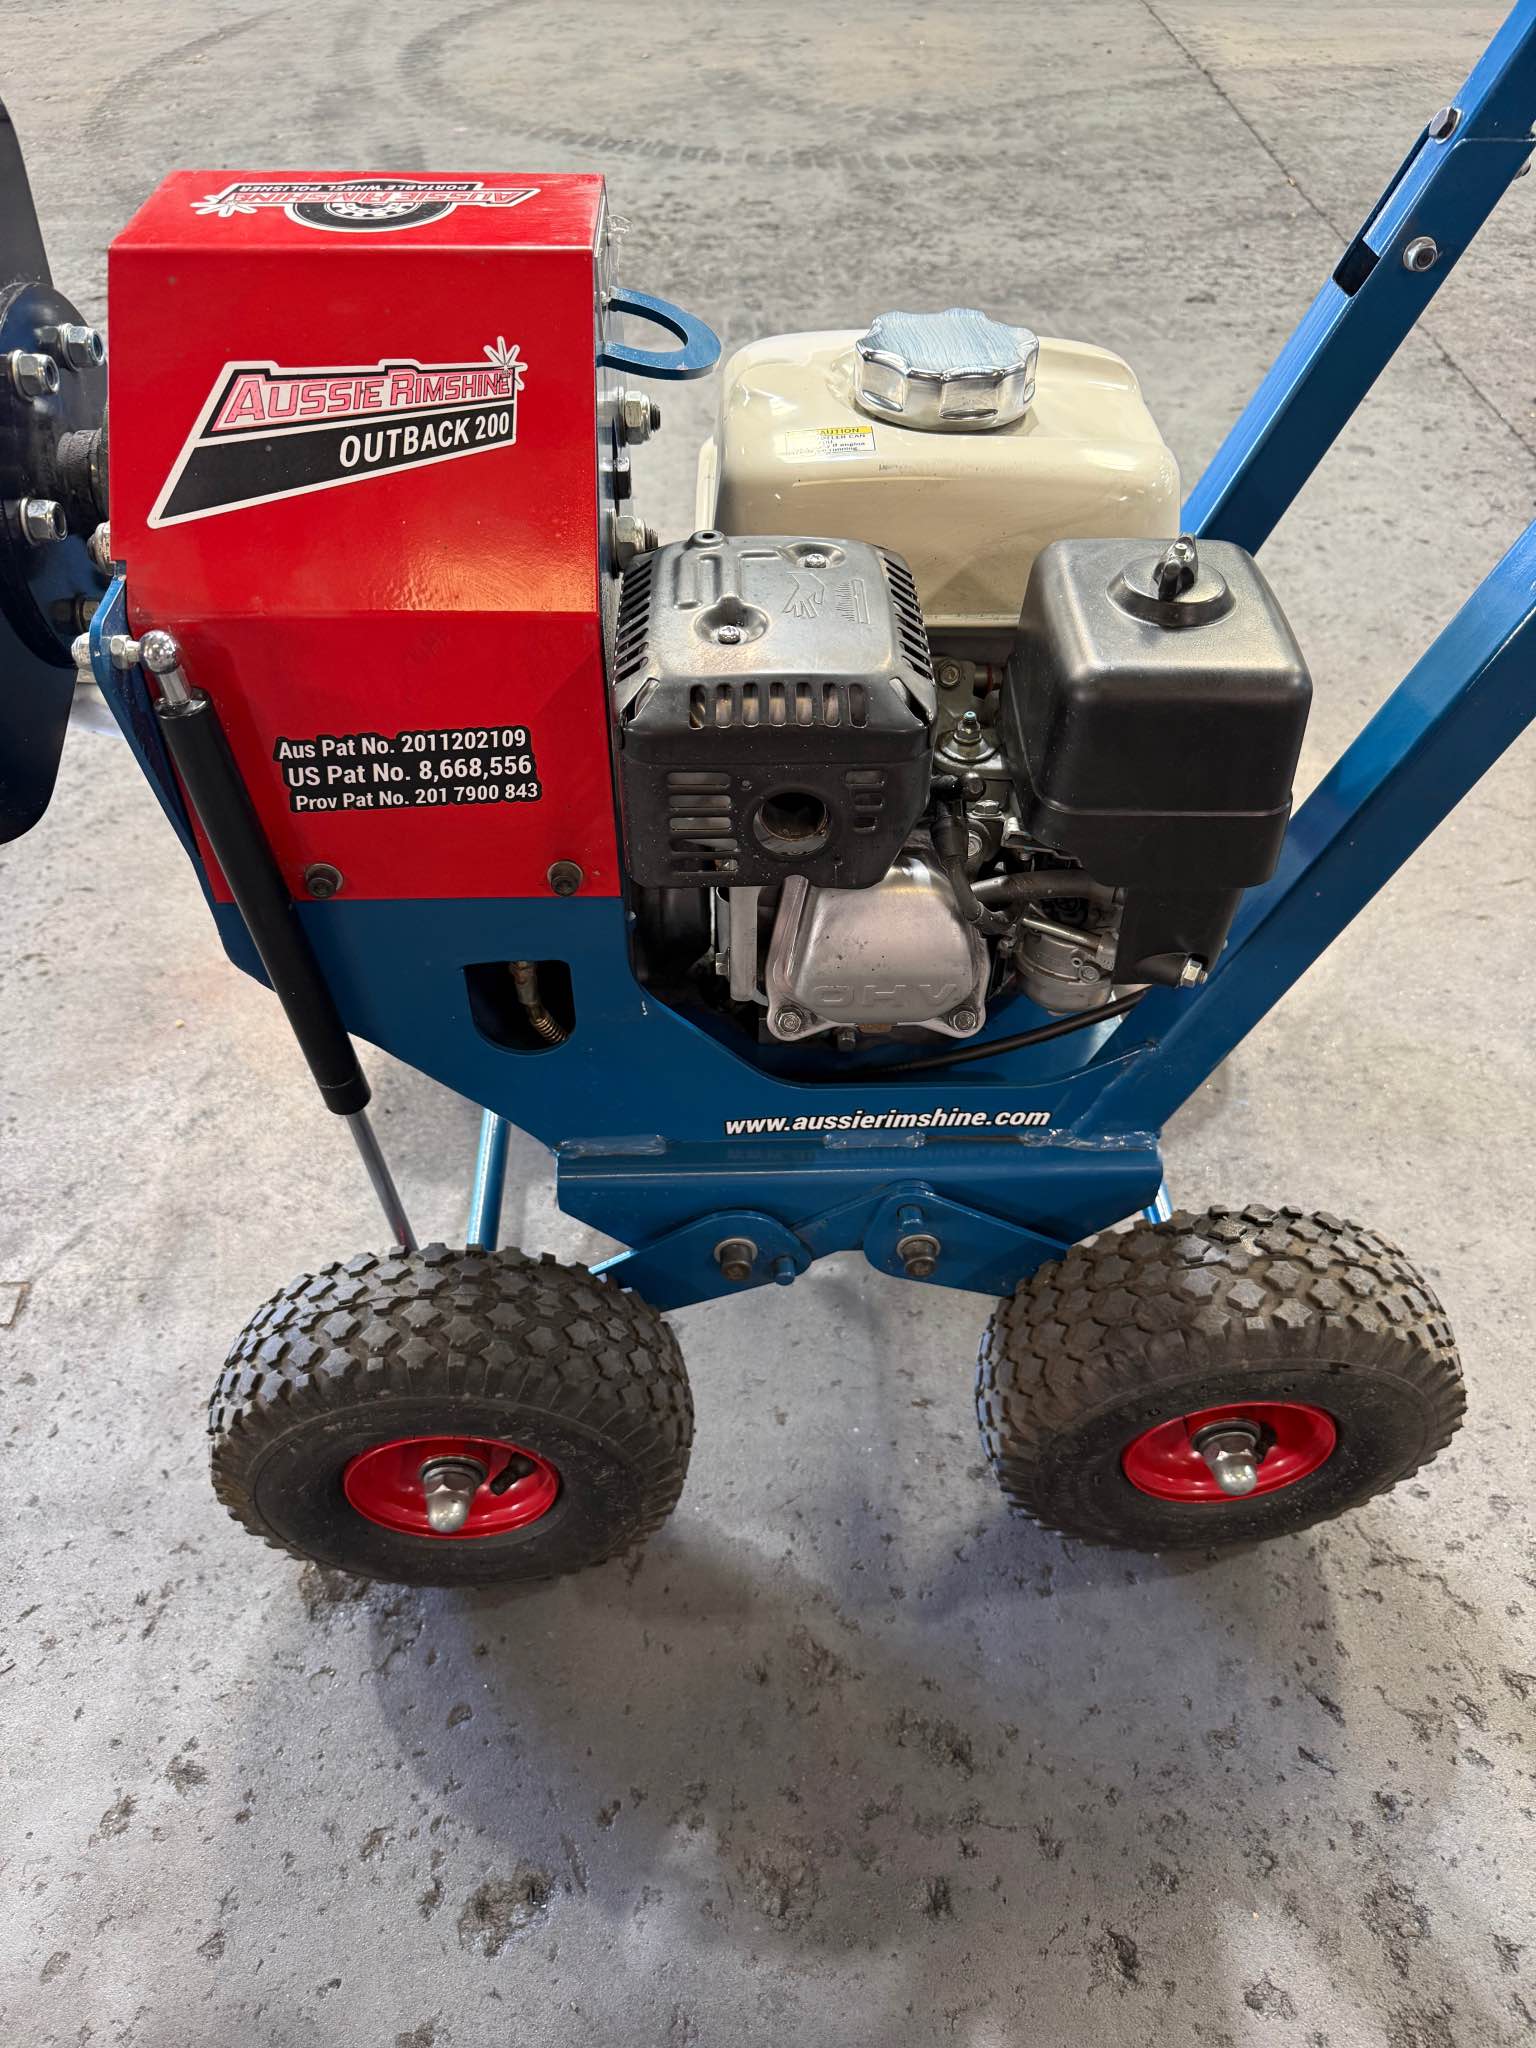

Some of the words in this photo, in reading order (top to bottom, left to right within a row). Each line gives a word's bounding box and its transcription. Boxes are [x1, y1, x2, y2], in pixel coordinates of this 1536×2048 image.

[328, 184, 381, 192] WHEEL
[399, 191, 521, 202] AUSSIE
[224, 380, 385, 423] AUSSIE
[390, 373, 512, 407] RIMSHINE
[339, 417, 471, 468] OUTBACK
[475, 411, 510, 440] 200
[279, 741, 316, 760] Aus
[322, 739, 356, 757] Pat
[362, 737, 395, 755] No.
[401, 728, 526, 753] 2011202109
[288, 765, 321, 787] US
[327, 764, 366, 785] Pat
[374, 762, 411, 782] No.
[419, 754, 532, 782] 8,668,556
[296, 793, 338, 811] Prov
[343, 791, 373, 807] Pat
[378, 789, 409, 806] No.
[415, 787, 447, 804] 201
[454, 784, 499, 802] 7900
[505, 782, 538, 799] 843
[815, 984, 957, 1008] OHV
[725, 1107, 1051, 1135] www.aussierimshine.com
